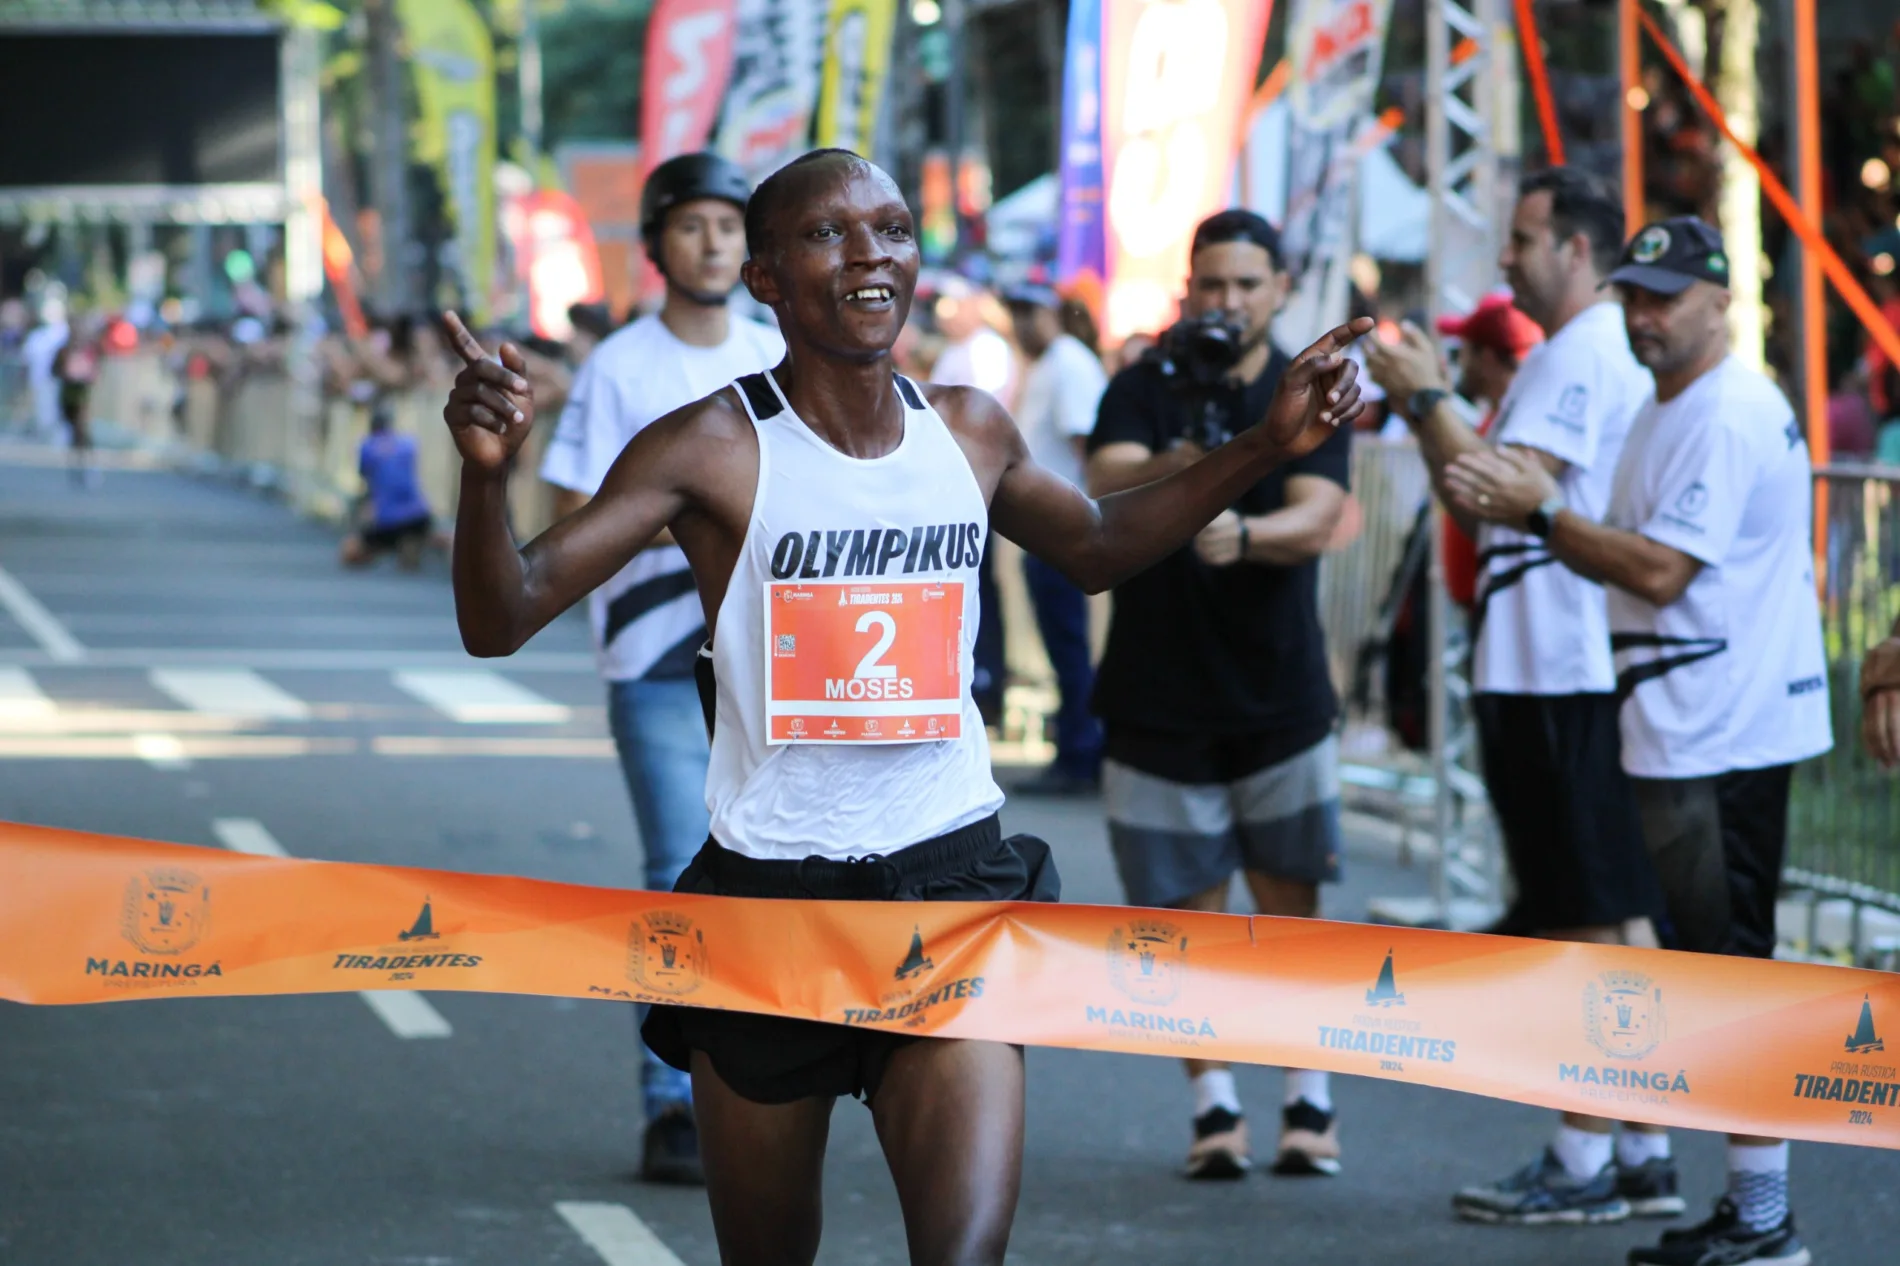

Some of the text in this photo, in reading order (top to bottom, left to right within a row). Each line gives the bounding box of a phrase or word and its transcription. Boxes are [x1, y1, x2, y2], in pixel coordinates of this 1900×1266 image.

[771, 522, 980, 580] OLYMPIKUS
[854, 611, 897, 678] 2
[825, 678, 913, 699] MOSES
[85, 957, 223, 978] MARINGÁ
[333, 953, 483, 970] TIRADENTES
[843, 977, 985, 1025] TIRADENTES
[1085, 1005, 1218, 1039] MARINGÁ
[1318, 1025, 1456, 1063] TIRADENTES
[1380, 1060, 1404, 1072] 2024
[1558, 1062, 1690, 1093] MARINGÁ
[1830, 1061, 1859, 1075] PROVA
[1579, 1086, 1669, 1105] PREFEITURA
[1794, 1073, 1900, 1107] TIRADENT
[1849, 1110, 1873, 1125] 2024
